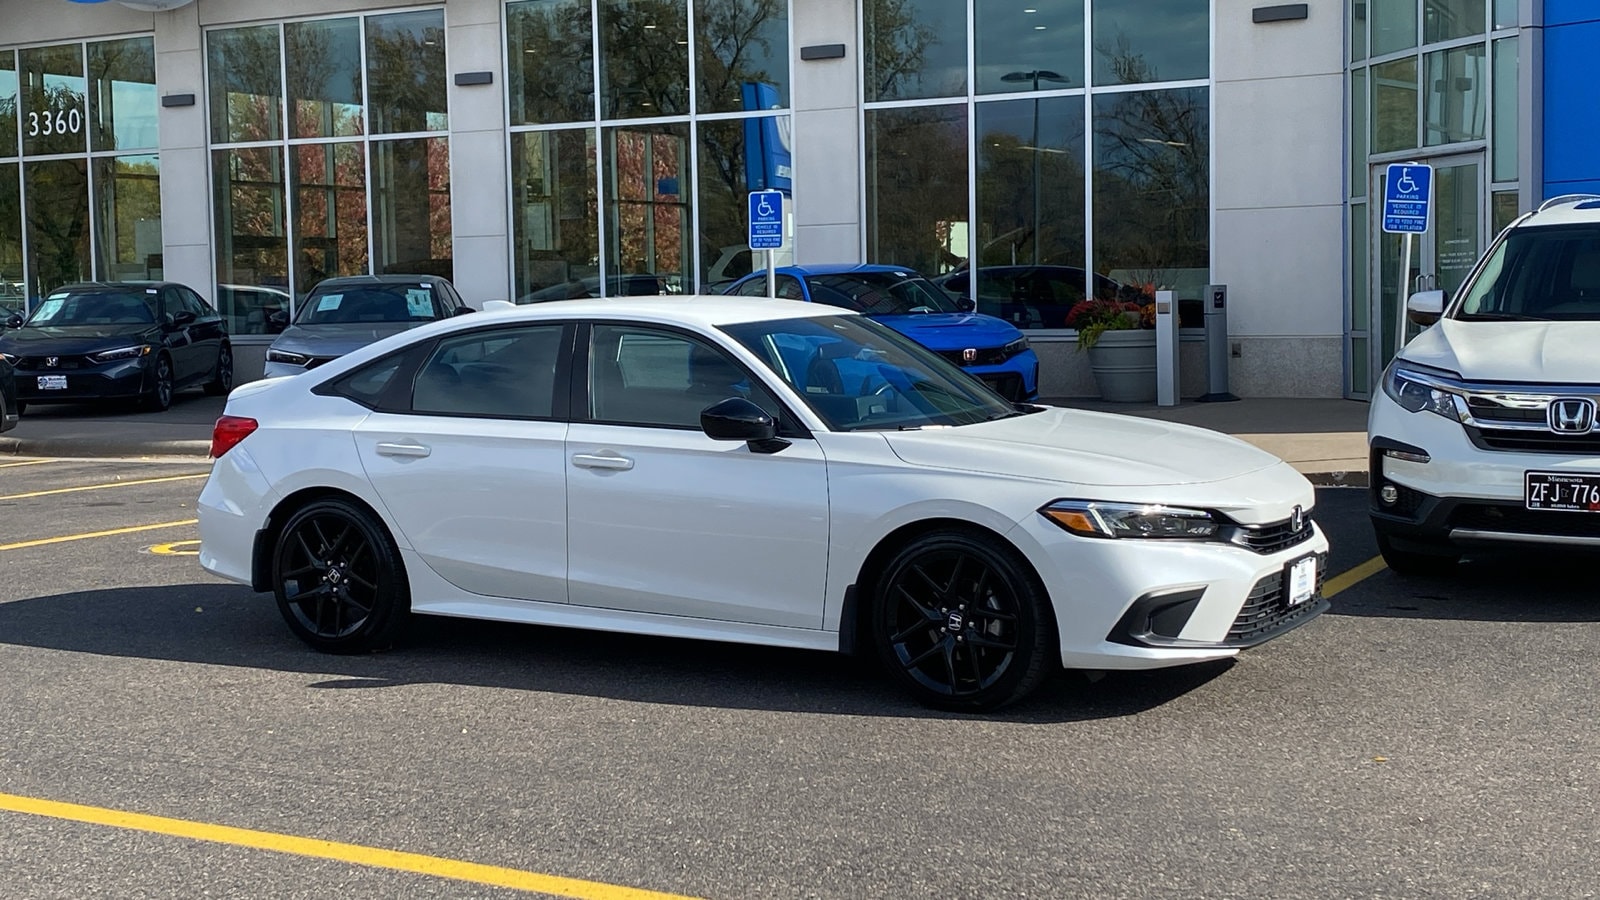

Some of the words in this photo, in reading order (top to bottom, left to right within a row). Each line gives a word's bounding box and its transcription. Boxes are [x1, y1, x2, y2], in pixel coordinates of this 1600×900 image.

[29, 109, 80, 136] 3360
[1531, 483, 1560, 502] ZFJ
[1571, 484, 1600, 504] 776
